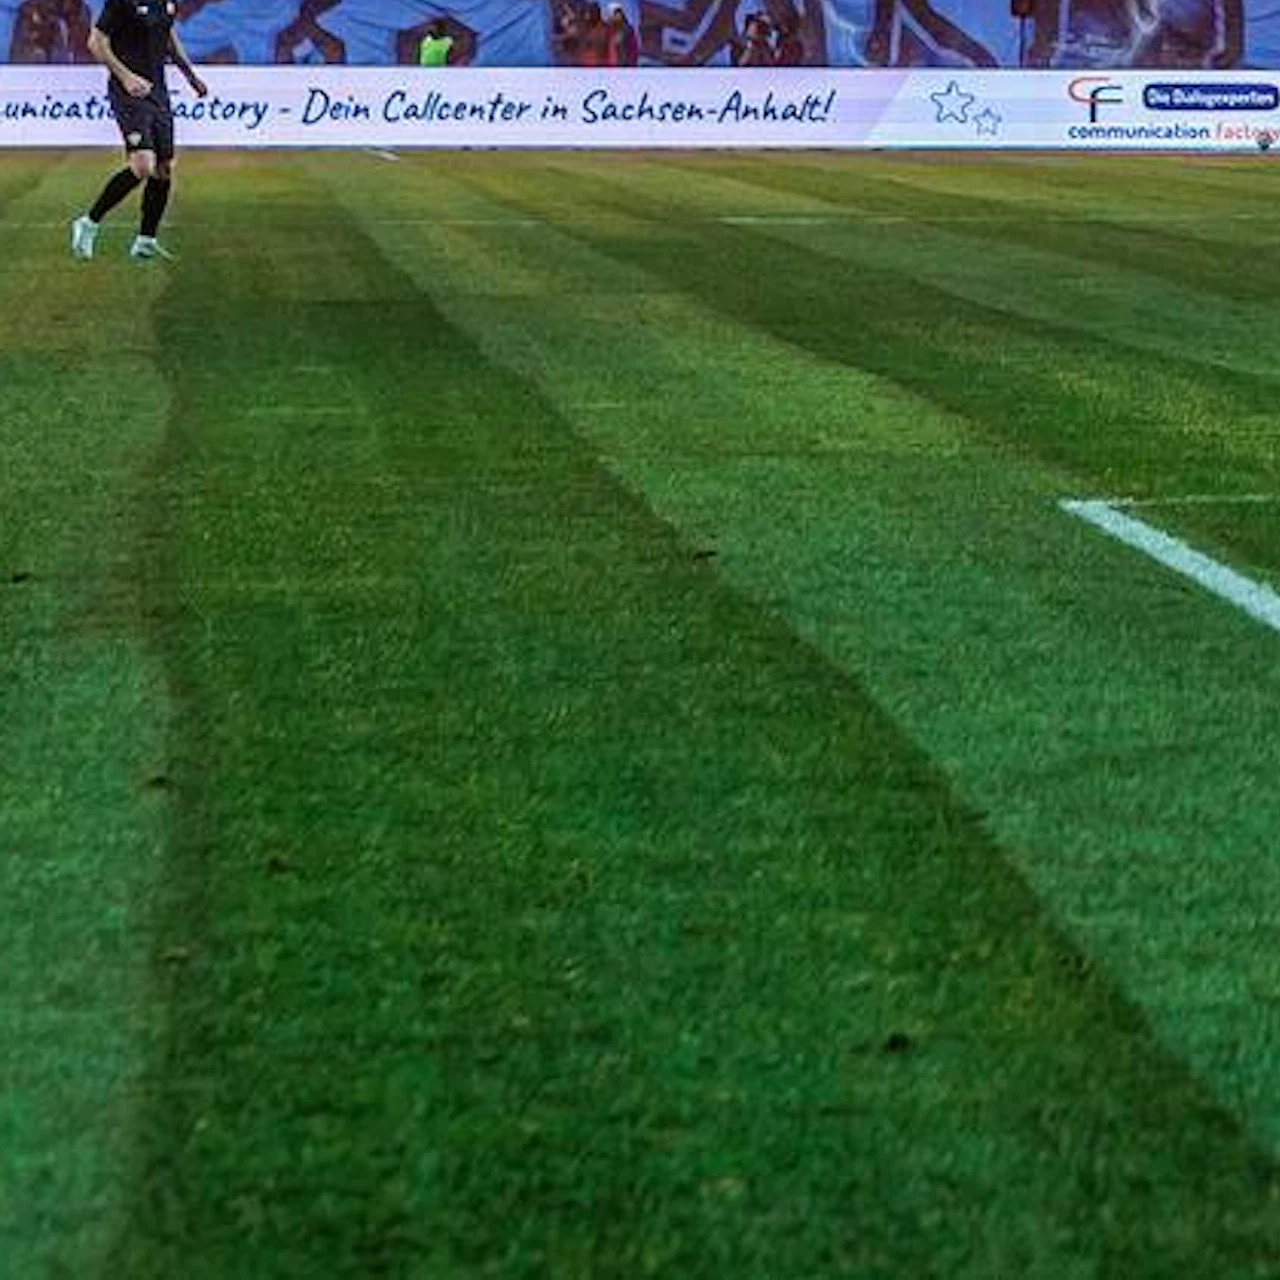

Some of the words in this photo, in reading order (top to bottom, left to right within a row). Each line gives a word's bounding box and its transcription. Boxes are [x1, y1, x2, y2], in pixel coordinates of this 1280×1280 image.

[169, 89, 270, 129] actory
[302, 87, 370, 125] Dein
[383, 89, 532, 124] Callcenter
[541, 95, 568, 121] in
[582, 88, 837, 124] Sachsen-Anhalt!
[1068, 123, 1210, 140] communication
